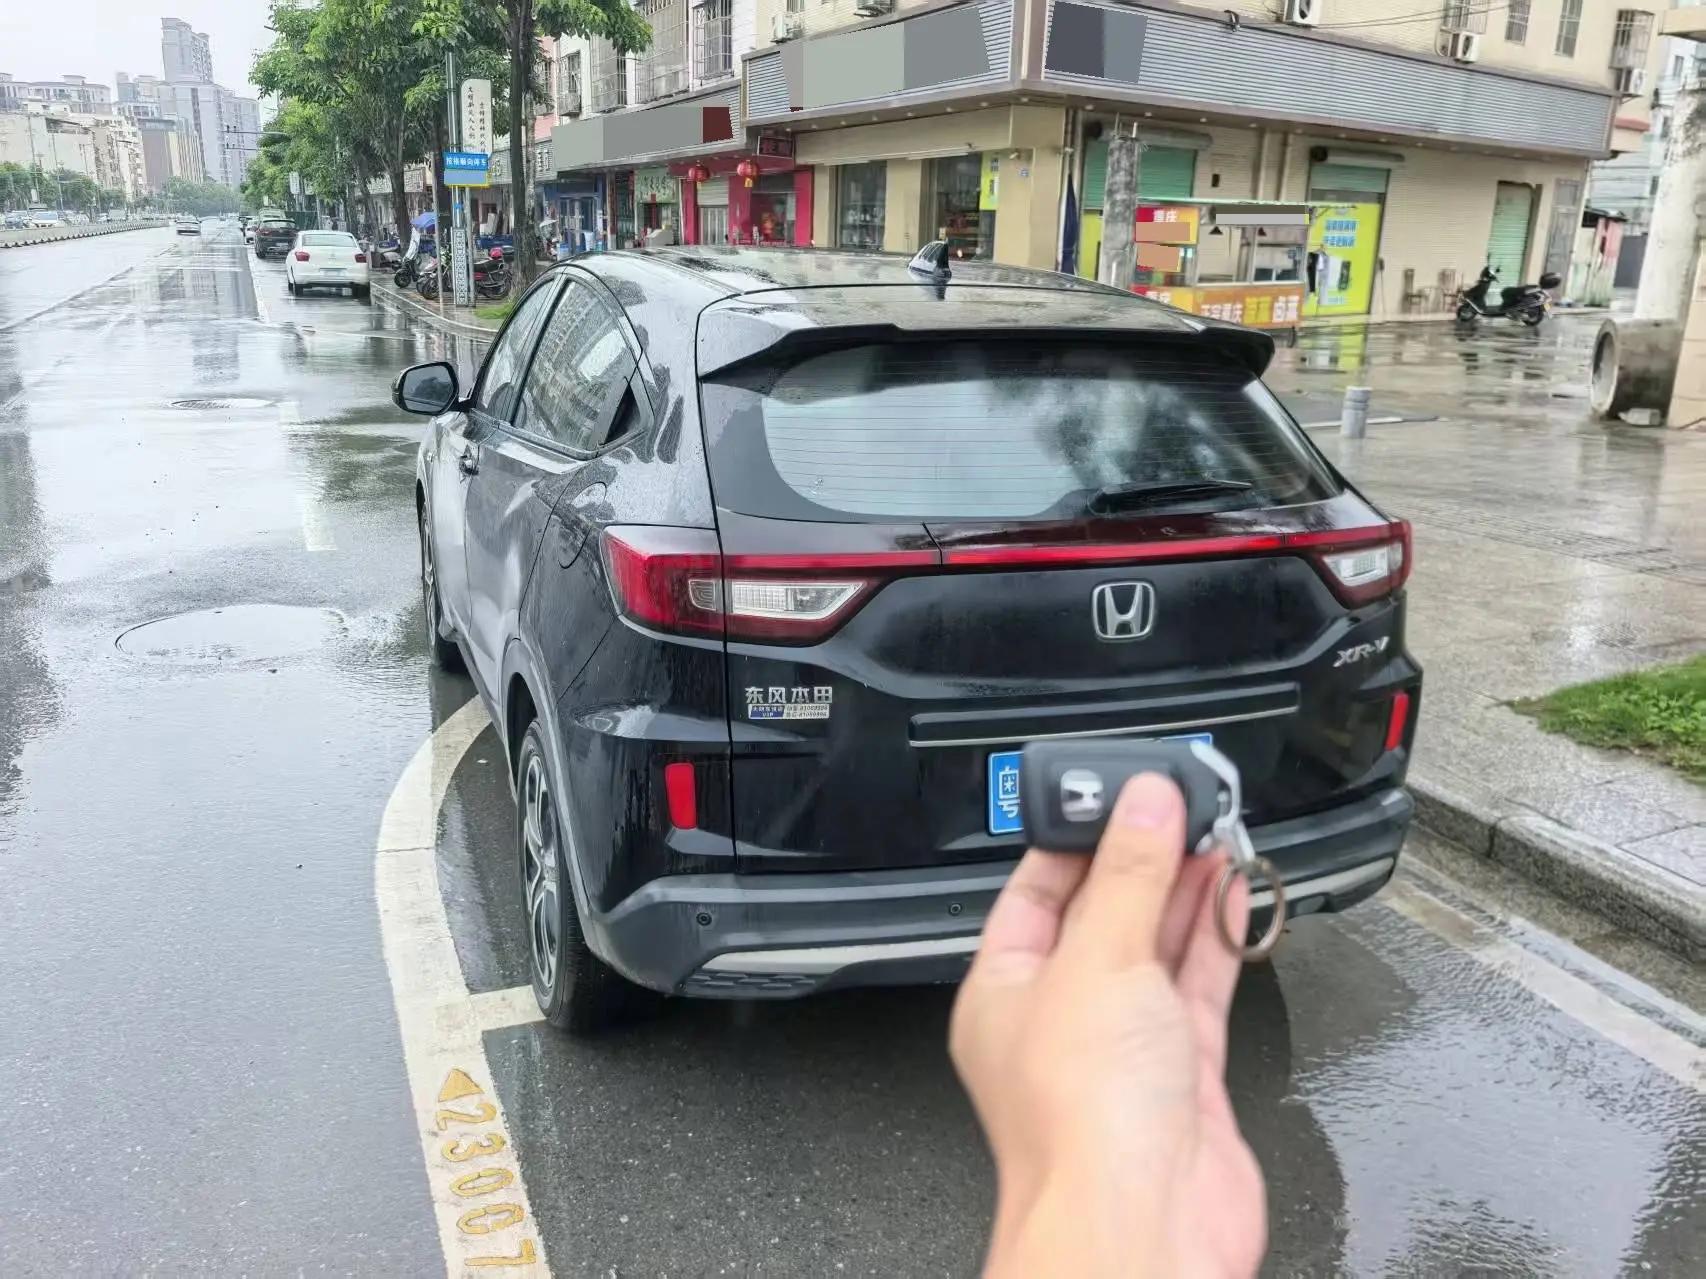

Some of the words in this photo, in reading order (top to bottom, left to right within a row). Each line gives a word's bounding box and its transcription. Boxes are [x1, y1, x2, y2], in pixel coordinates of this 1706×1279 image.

[1333, 636, 1390, 668] XR-V
[745, 686, 833, 704] 东风本田
[435, 1102, 537, 1267] 23007
